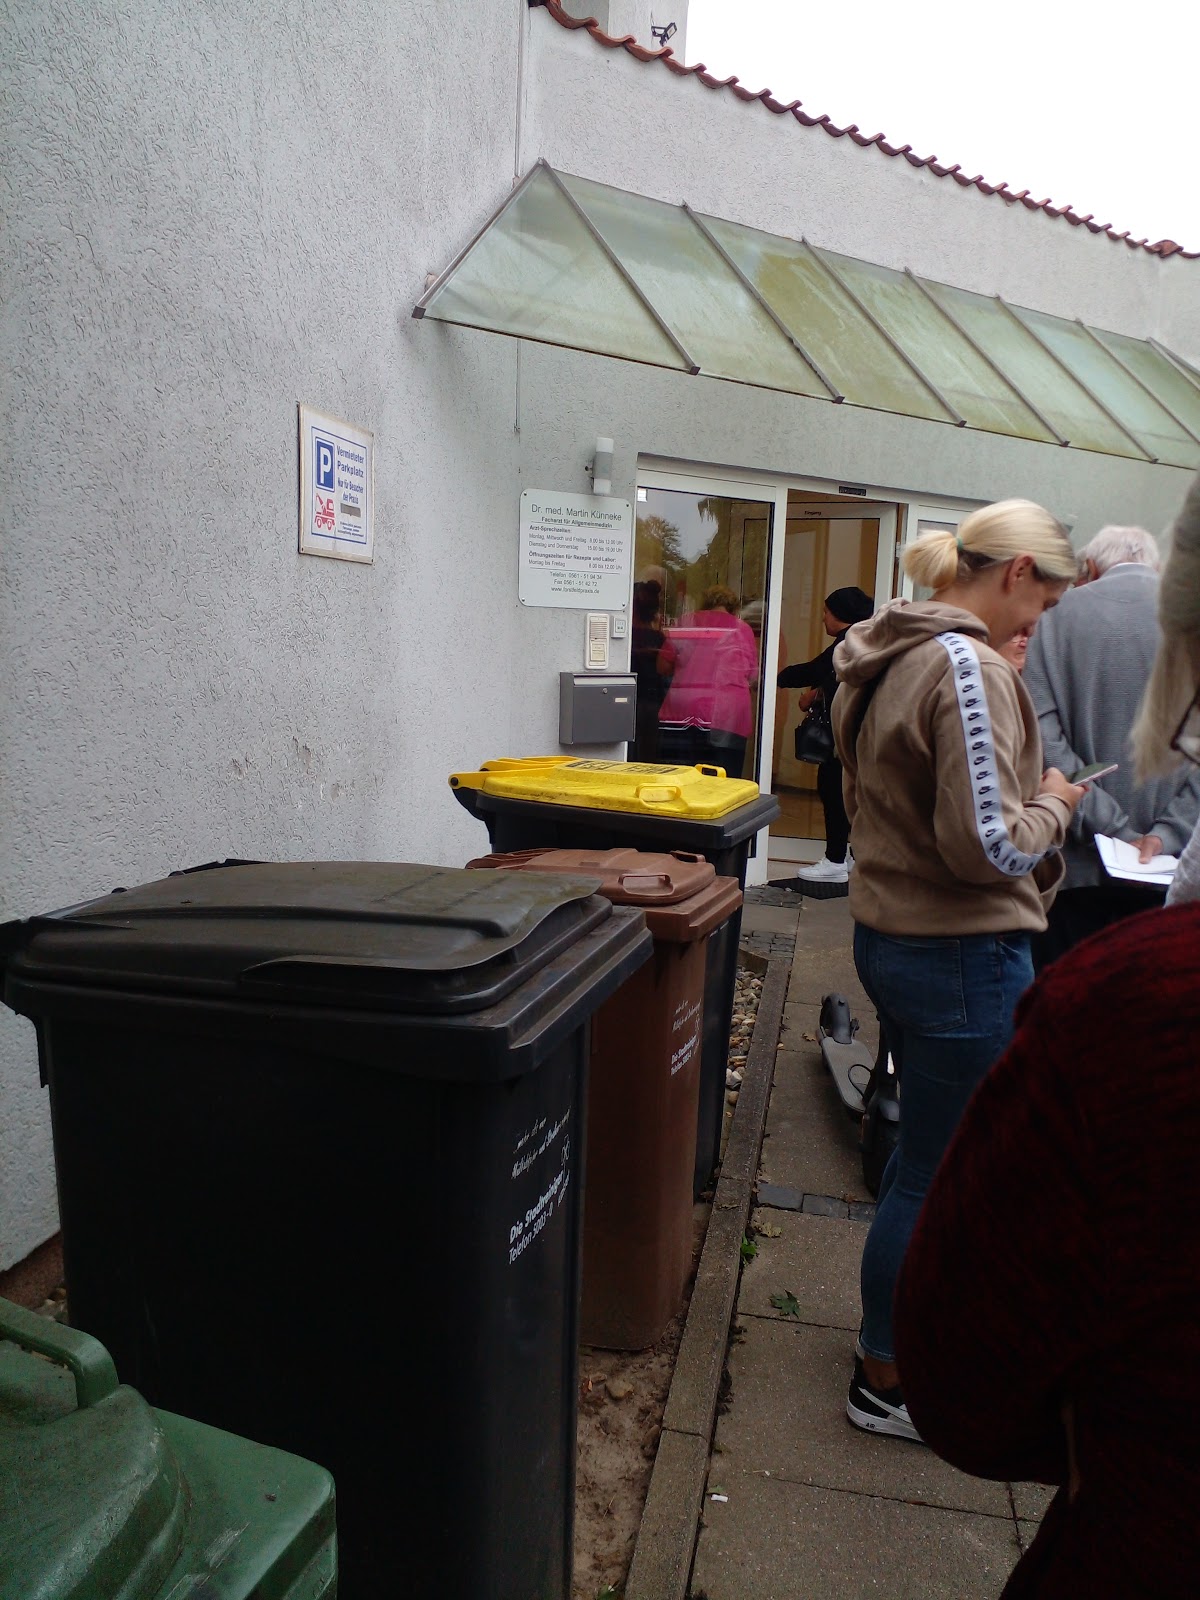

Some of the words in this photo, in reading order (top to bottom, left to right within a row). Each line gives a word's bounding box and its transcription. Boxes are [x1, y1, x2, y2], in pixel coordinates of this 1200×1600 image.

[337, 445, 364, 464] Vermieteter
[320, 446, 331, 484] P
[338, 461, 364, 478] Parkplatz
[532, 504, 542, 513] Dr.
[546, 507, 563, 515] med.
[567, 508, 588, 518] Martin
[591, 510, 621, 521] Künneke
[572, 520, 612, 528] Allgemeinmedizin
[529, 551, 564, 559] Öffnungszeiten
[510, 1220, 523, 1244] Die
[525, 1170, 564, 1228] Stadtreiniger
[509, 1232, 532, 1264] Telefon
